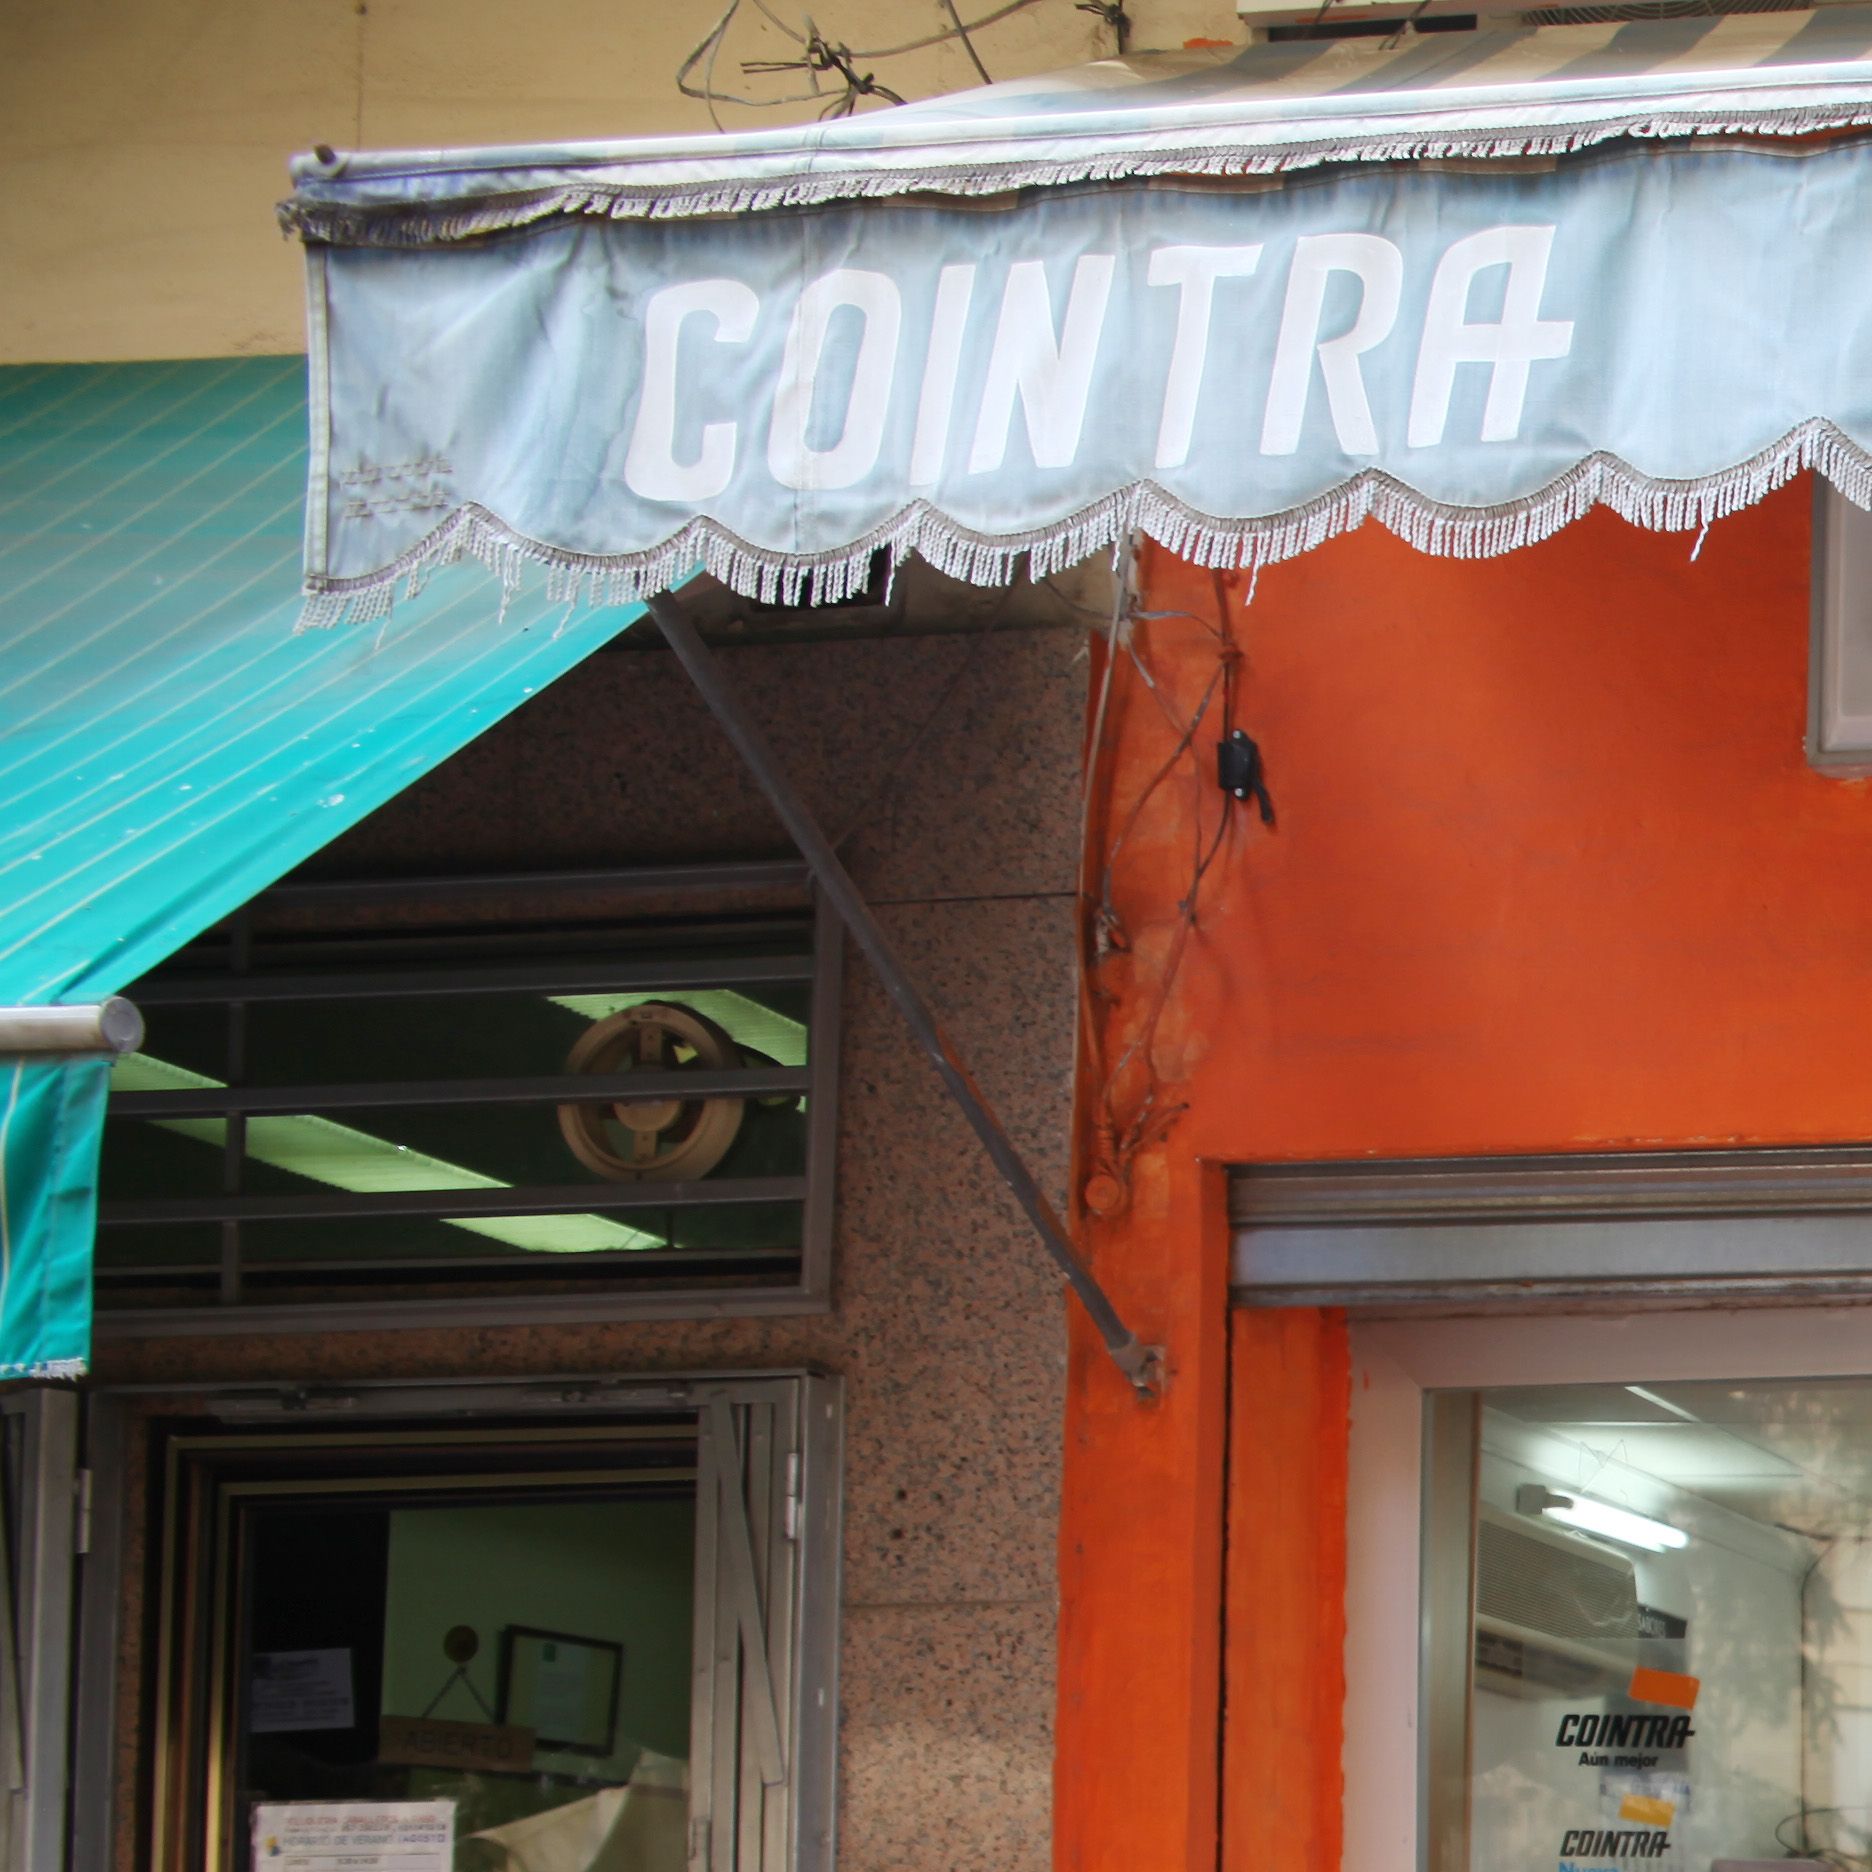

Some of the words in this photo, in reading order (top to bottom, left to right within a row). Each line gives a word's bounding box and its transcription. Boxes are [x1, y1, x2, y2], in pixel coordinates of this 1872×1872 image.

[625, 224, 1576, 503] COINTRA
[403, 1730, 515, 1760] ABIERTO
[1555, 1713, 1695, 1749] COINTRA
[1578, 1750, 1609, 1768] Aún
[1614, 1752, 1659, 1770] mejor
[1559, 1829, 1672, 1858] COINTRA
